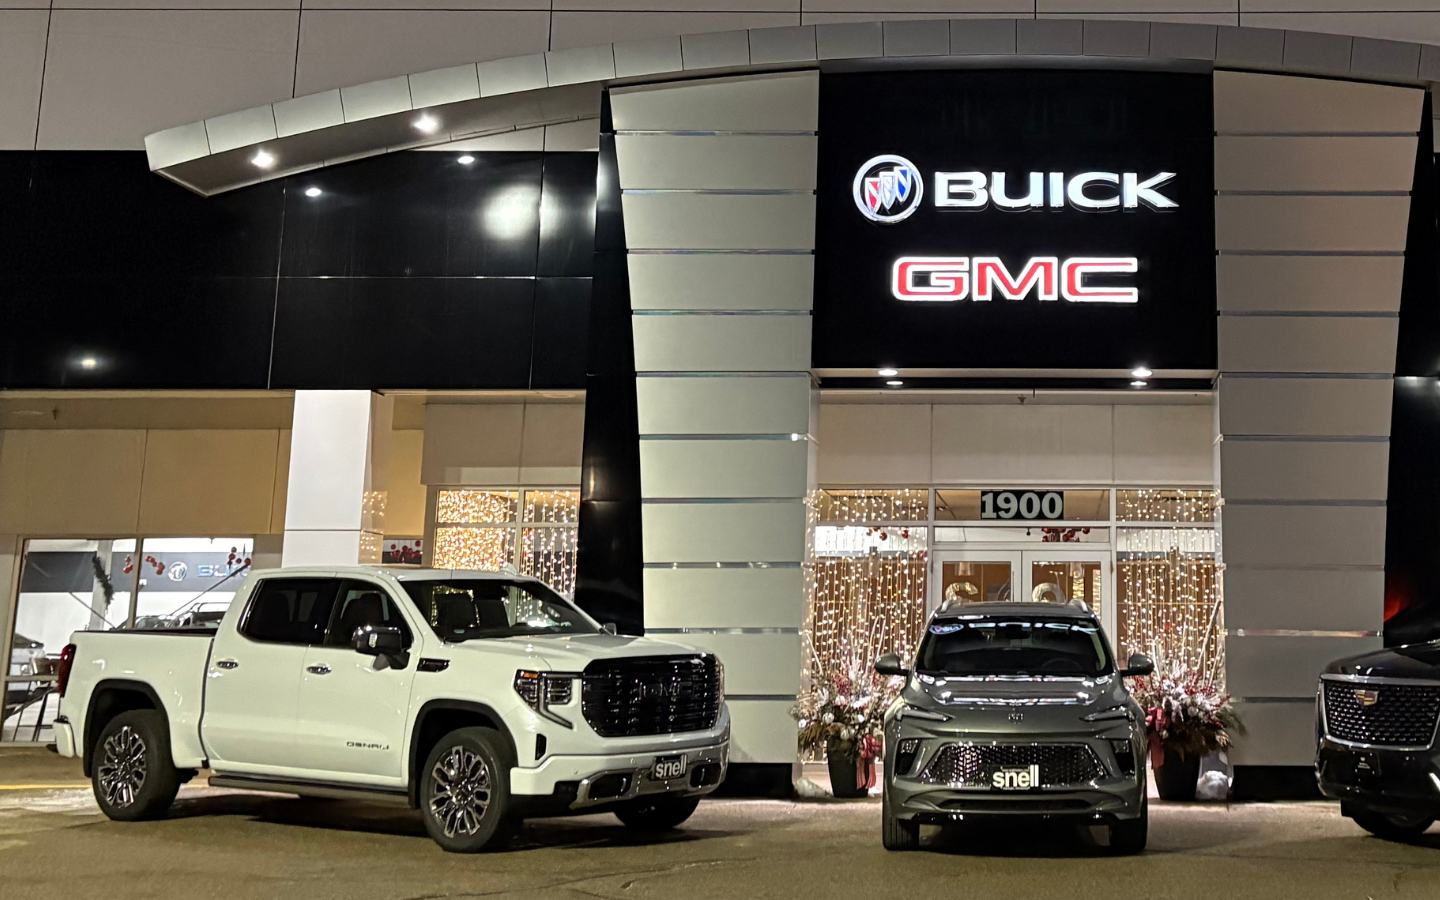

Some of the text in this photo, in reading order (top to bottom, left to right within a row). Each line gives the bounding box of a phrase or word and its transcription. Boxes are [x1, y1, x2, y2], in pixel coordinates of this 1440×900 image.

[934, 171, 1180, 208] BUICK
[891, 256, 1139, 303] GMC
[981, 491, 1063, 519] 1900
[655, 754, 687, 779] snell
[992, 764, 1040, 788] snell
